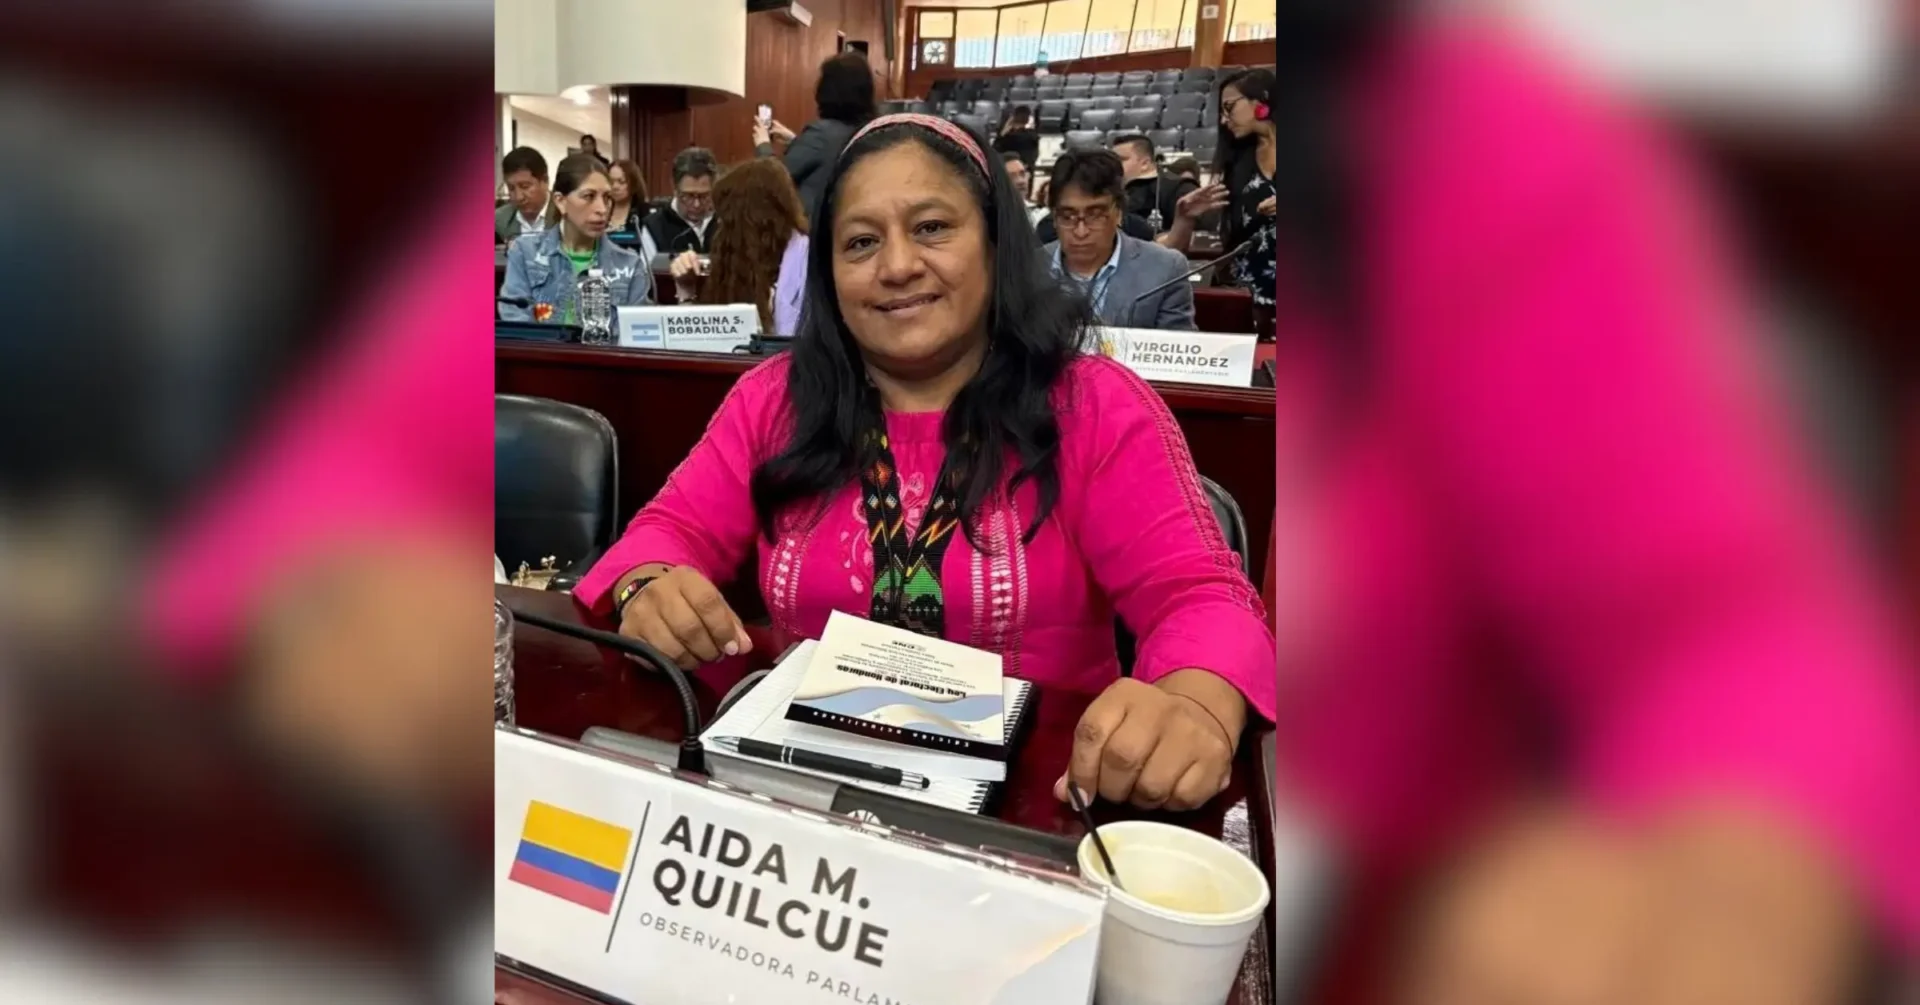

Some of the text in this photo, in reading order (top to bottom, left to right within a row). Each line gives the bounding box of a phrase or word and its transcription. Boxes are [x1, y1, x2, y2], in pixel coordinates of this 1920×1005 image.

[667, 316, 744, 326] KAROLINA S.
[668, 326, 738, 335] BOBADILLA
[1133, 341, 1202, 355] VIRGILIO
[1131, 352, 1229, 368] HERNANDEZ
[836, 664, 884, 682] Honduras
[884, 674, 898, 684] de
[899, 677, 945, 695] Electoral
[947, 687, 967, 699] Ley
[660, 814, 788, 885] AIDA
[810, 856, 870, 910] M.
[652, 858, 889, 968] QUILCUE
[639, 912, 795, 979] OBSERVADORA
